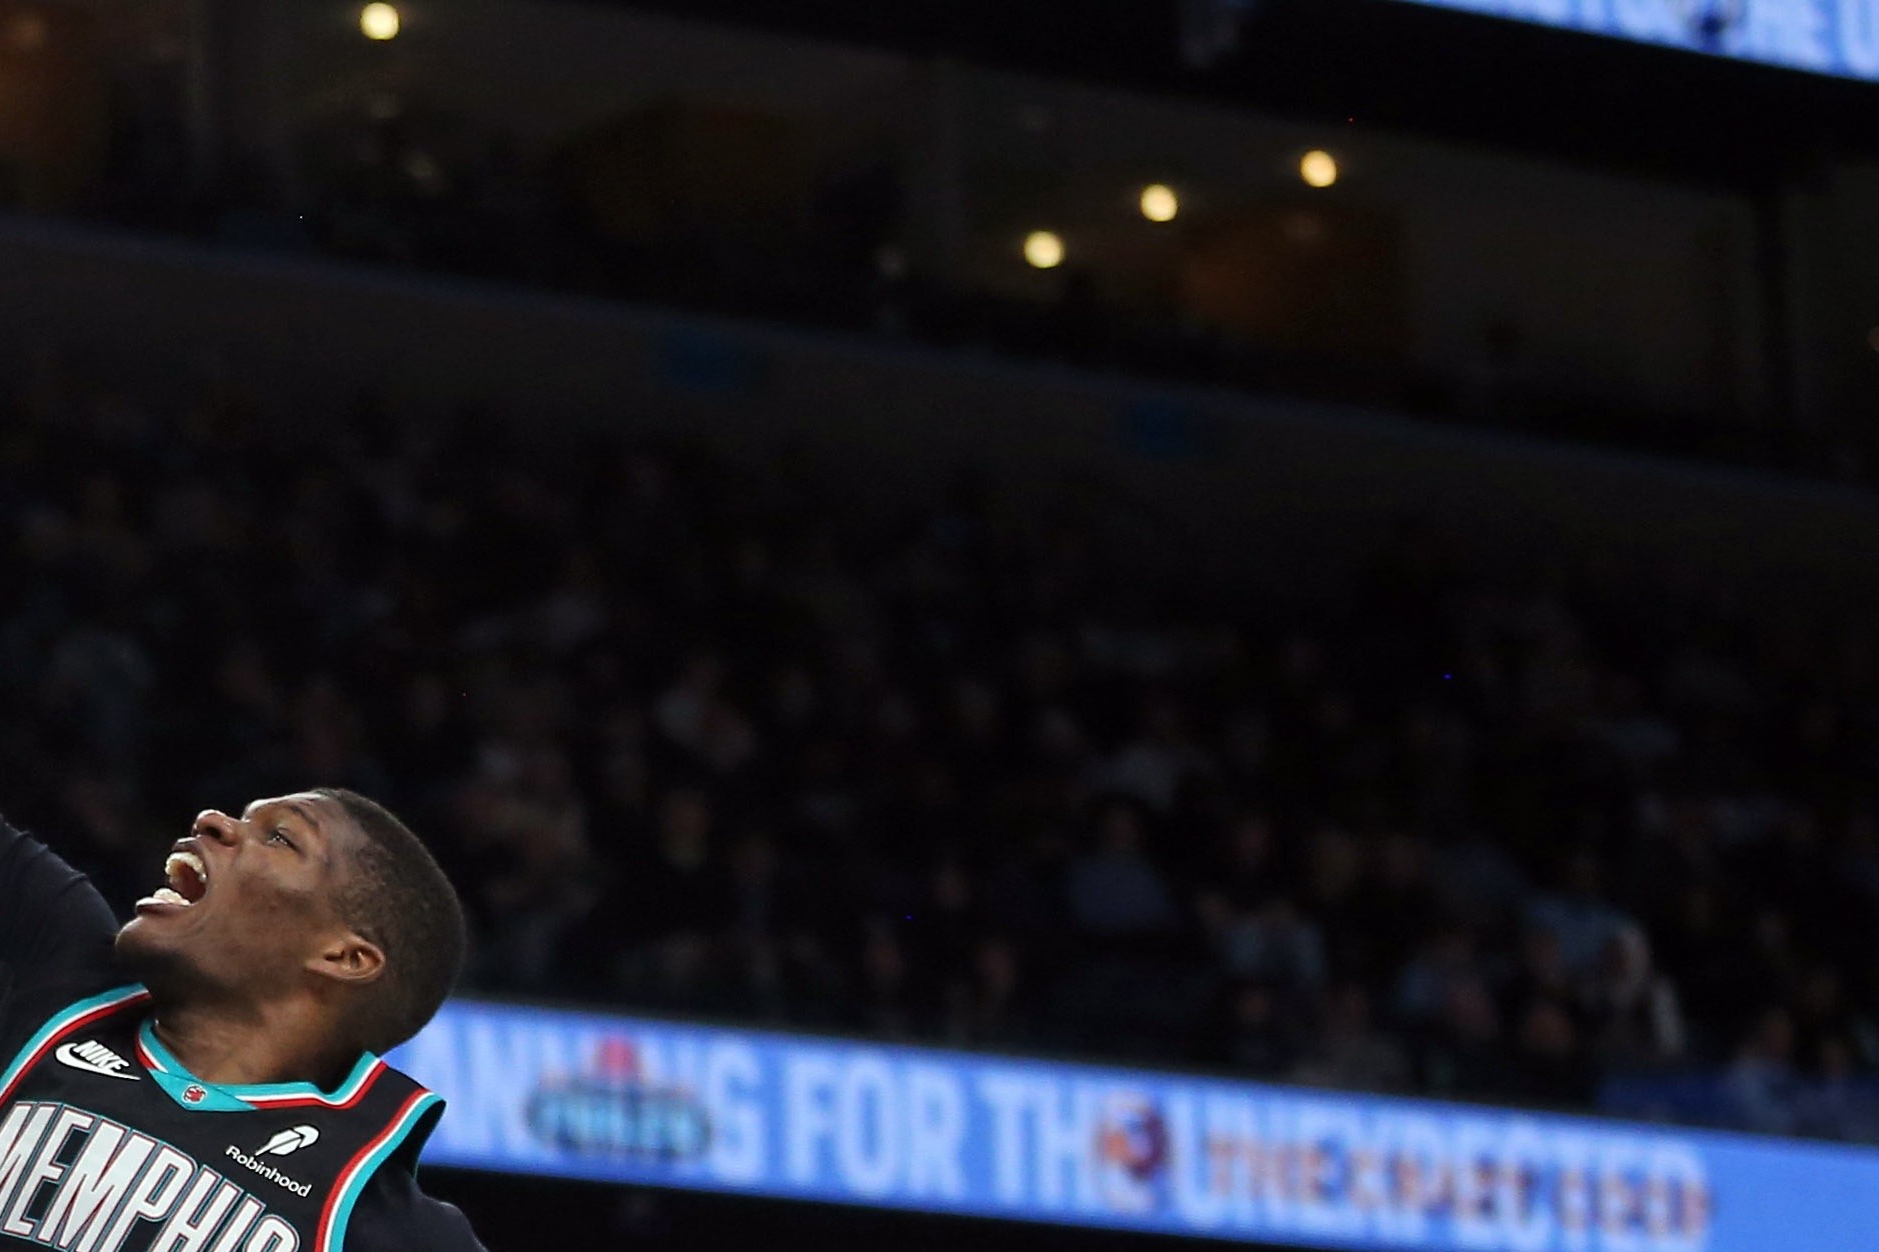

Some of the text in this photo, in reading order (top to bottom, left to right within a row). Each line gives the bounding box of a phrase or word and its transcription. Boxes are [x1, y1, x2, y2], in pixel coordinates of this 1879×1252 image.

[71, 1039, 130, 1074] NIKE
[785, 1046, 967, 1199] FOR
[225, 1144, 313, 1198] Robinhood
